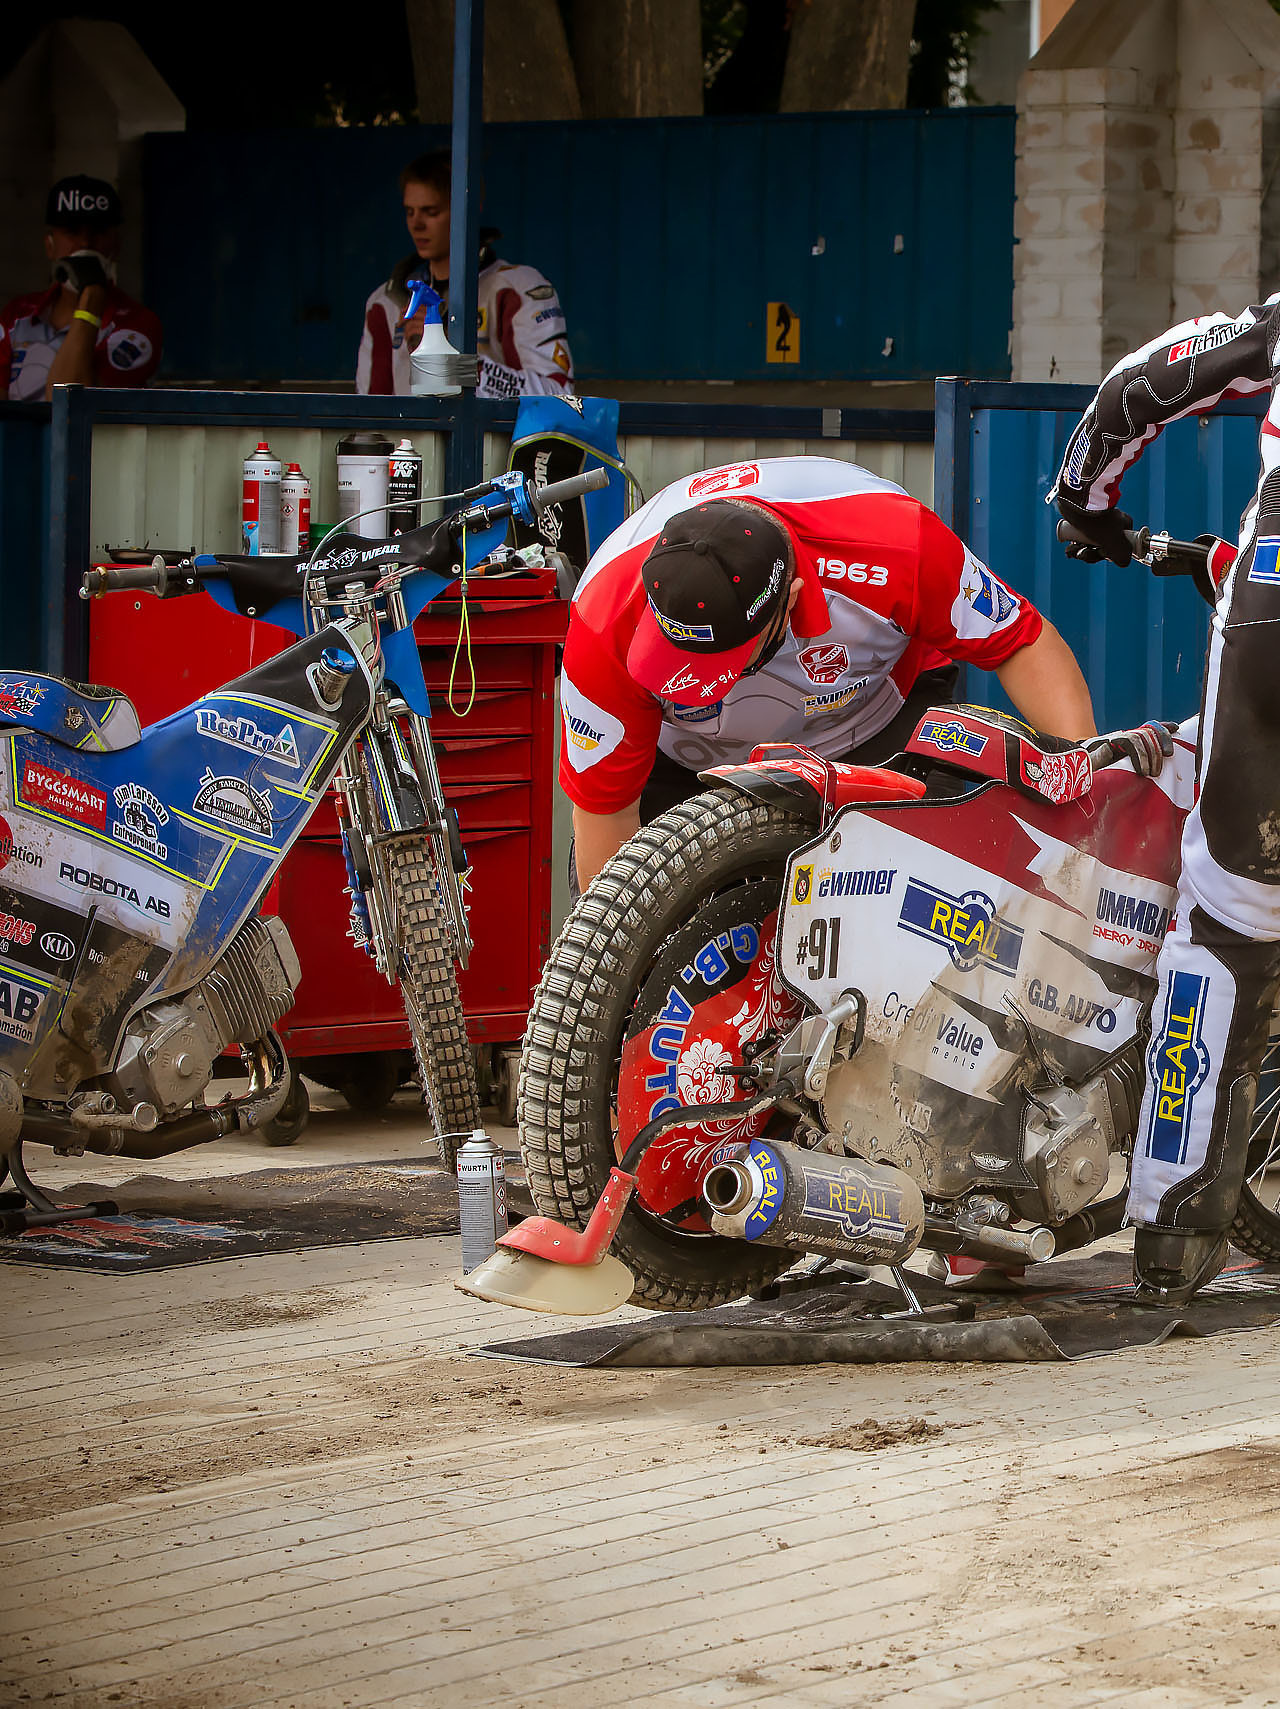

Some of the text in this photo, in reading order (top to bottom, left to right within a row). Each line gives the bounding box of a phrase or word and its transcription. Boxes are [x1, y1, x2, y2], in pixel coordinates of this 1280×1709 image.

[57, 190, 109, 212] Nice
[775, 303, 791, 352] 2
[534, 450, 552, 488] RAC
[816, 557, 889, 587] 1963
[199, 711, 275, 752] ResPro
[930, 726, 970, 748] REALL
[27, 769, 106, 813] BYGGSMART
[113, 785, 130, 807] Jim
[130, 784, 169, 825] Larsson
[59, 861, 171, 919] ROBOTA AB
[818, 868, 897, 899] ewinner
[45, 936, 71, 959] KIA
[796, 916, 842, 981] #91
[929, 900, 999, 960] REALL
[1092, 924, 1135, 947] ENERGY
[679, 922, 760, 985] G.B.
[1028, 978, 1117, 1034] G.B. AUTO
[937, 1013, 984, 1057] Value
[1158, 1006, 1196, 1123] REALL
[751, 1150, 778, 1223] REALL
[828, 1182, 892, 1219] REALL
